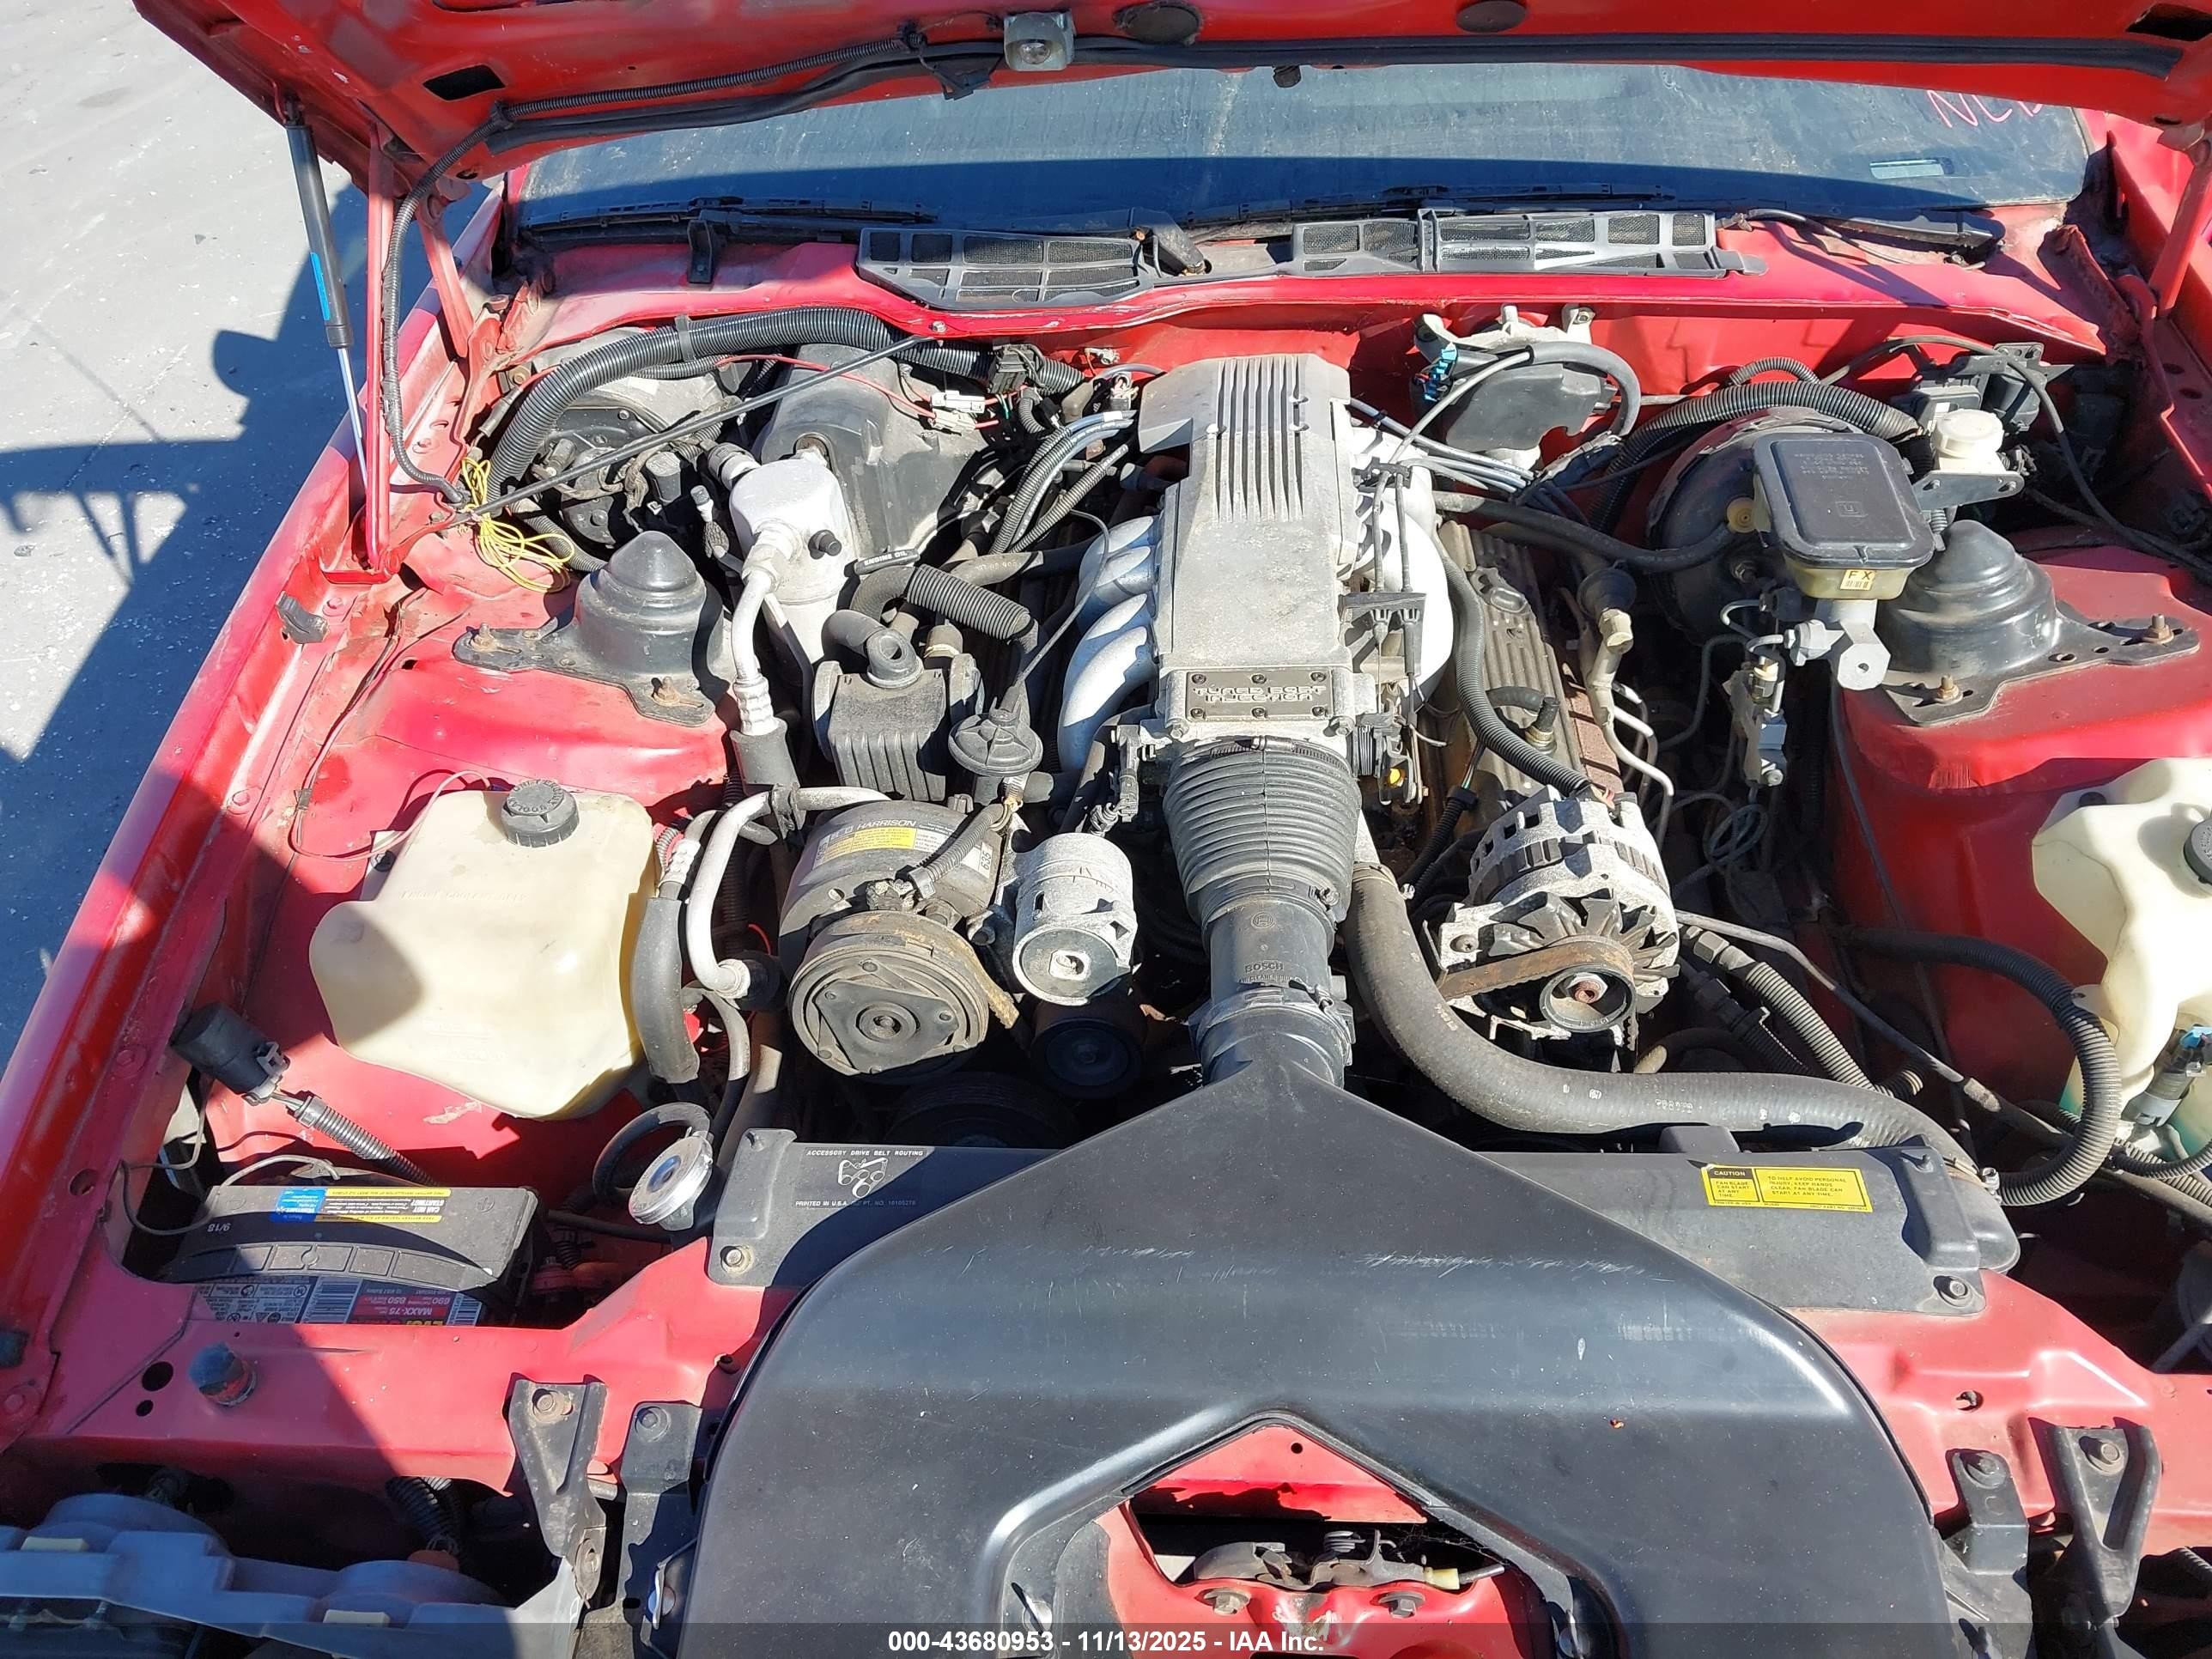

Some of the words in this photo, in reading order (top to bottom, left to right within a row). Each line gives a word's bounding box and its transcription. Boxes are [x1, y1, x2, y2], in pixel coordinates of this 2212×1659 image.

[864, 554, 893, 566] ENGINE
[894, 550, 908, 559] OIL
[1848, 570, 1858, 579] F
[1861, 570, 1871, 580] X
[857, 819, 917, 830] HARRISON
[980, 851, 992, 871] 635
[1244, 960, 1285, 974] BOSCH
[207, 1223, 232, 1232] 9/18
